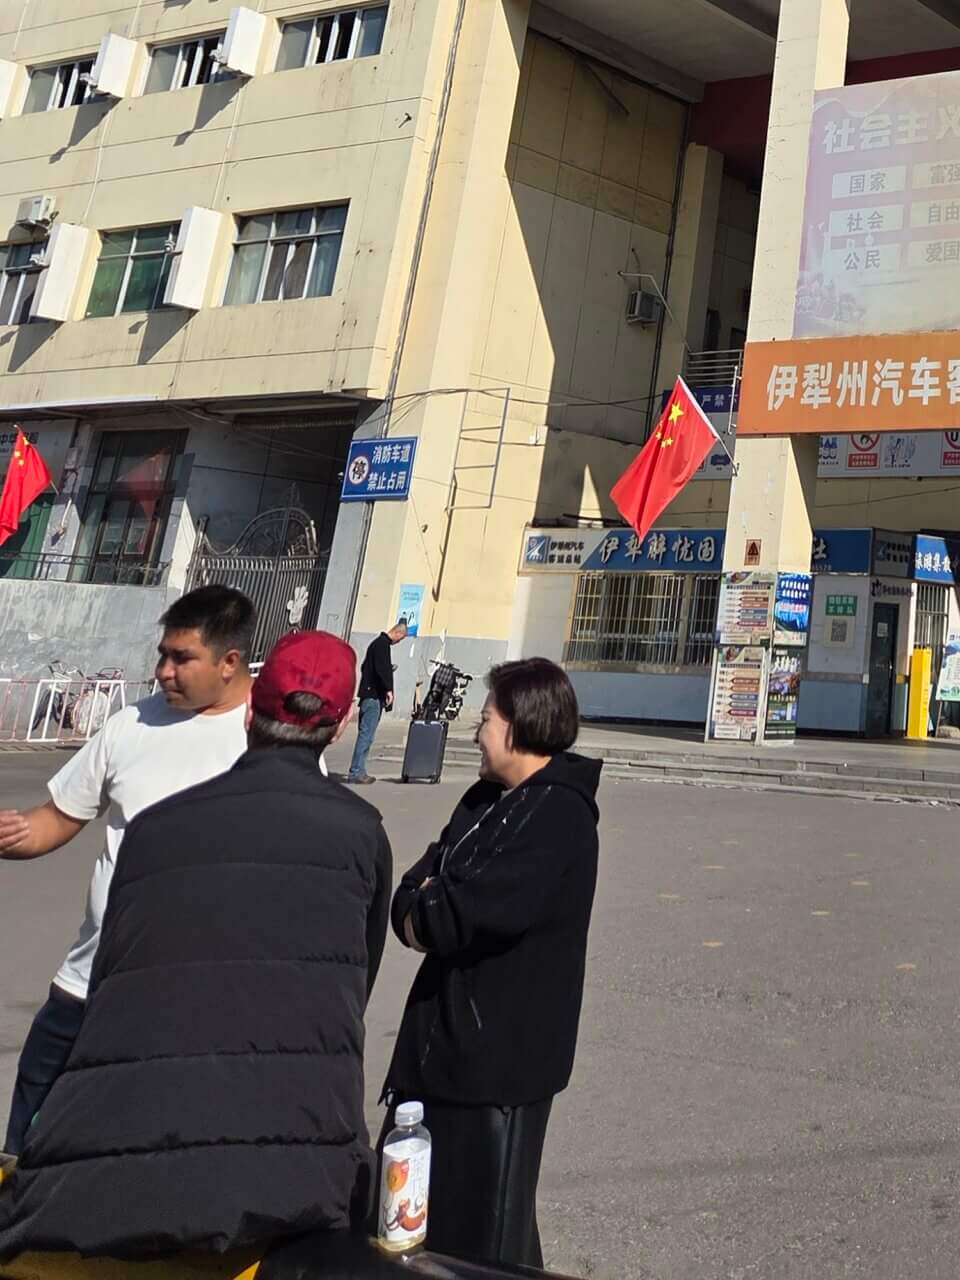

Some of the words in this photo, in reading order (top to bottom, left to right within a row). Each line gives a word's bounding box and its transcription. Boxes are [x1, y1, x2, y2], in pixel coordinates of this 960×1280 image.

[847, 170, 887, 194] 国家
[845, 210, 885, 233] 社会
[843, 248, 882, 272] 公民
[371, 443, 411, 465] 消防车道
[366, 471, 407, 491] 禁止占用
